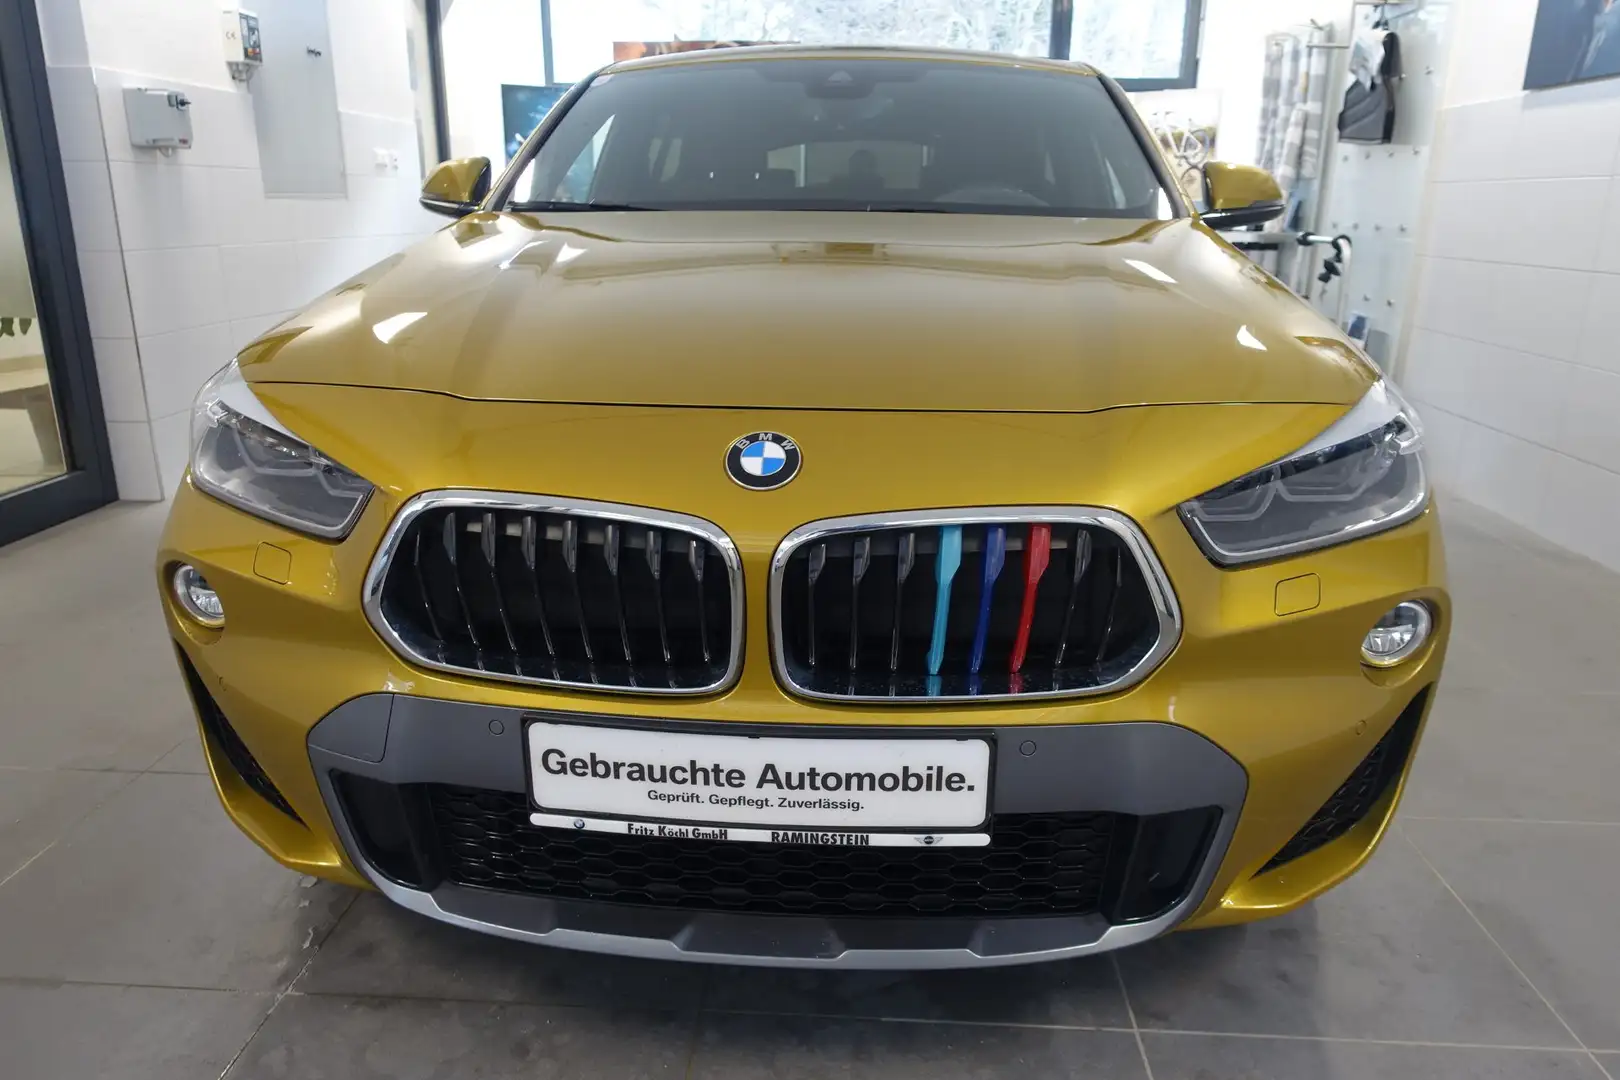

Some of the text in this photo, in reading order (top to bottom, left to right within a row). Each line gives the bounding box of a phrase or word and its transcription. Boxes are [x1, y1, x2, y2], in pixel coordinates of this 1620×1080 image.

[735, 433, 796, 450] BMW
[541, 748, 976, 792] Gebrauchte Automobile.
[647, 789, 864, 811] Geprüft. Gepflegt. Zuverlässig.
[627, 823, 728, 840] Fritz Köchl GmbH
[771, 831, 869, 846] RAMINGSTEIN
